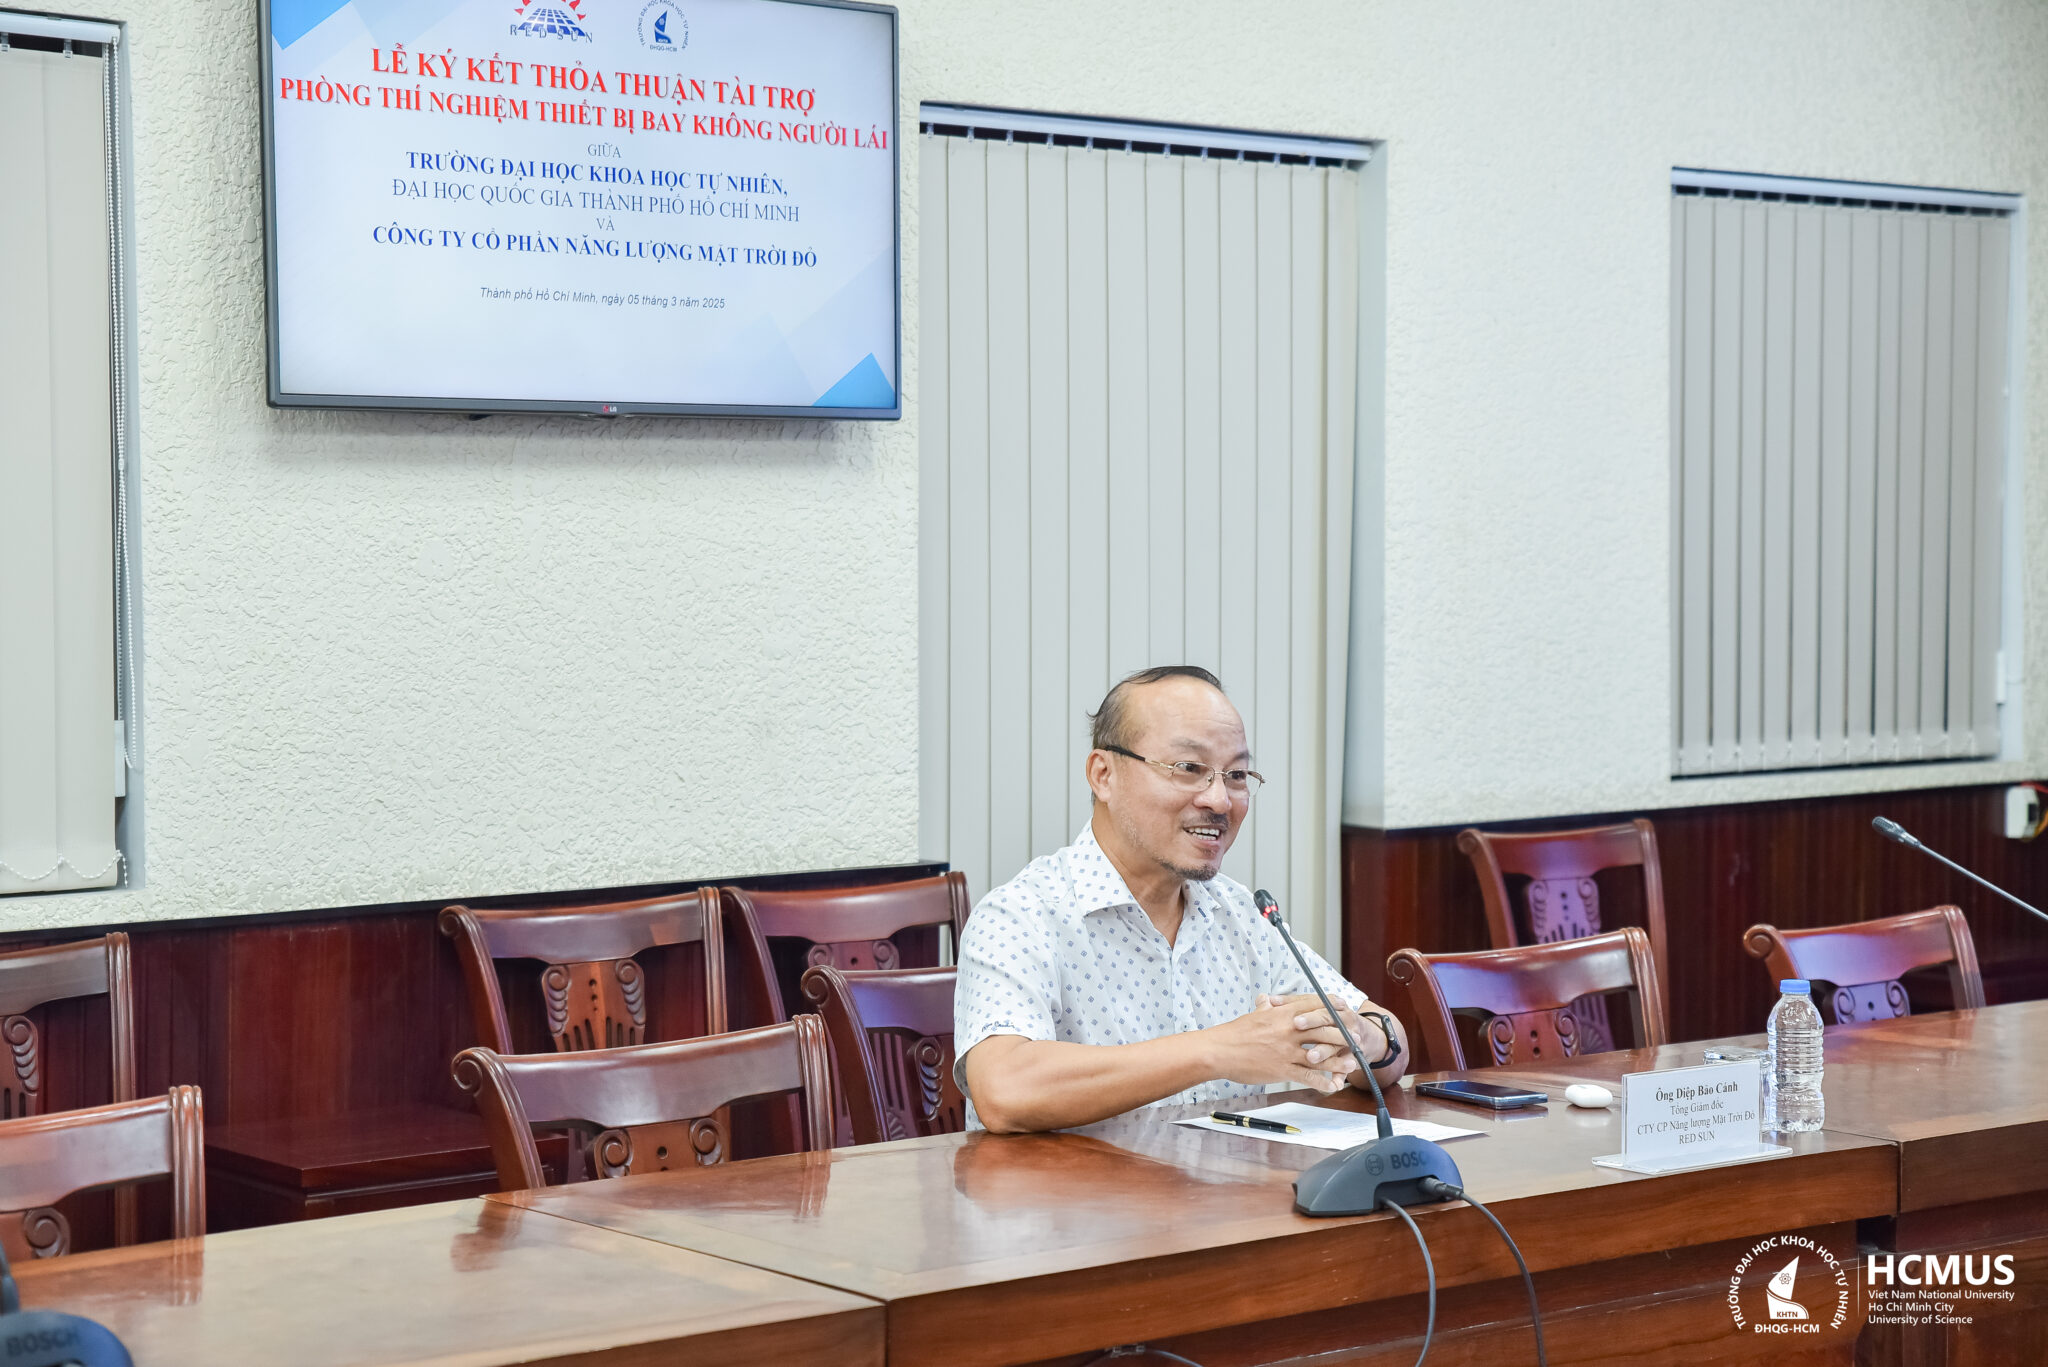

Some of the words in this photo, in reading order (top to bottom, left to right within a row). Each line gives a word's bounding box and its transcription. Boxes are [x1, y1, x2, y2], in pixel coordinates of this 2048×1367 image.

[371, 42, 410, 74] LỄ
[417, 48, 457, 79] KÝ
[466, 52, 523, 85] KẾT
[530, 59, 607, 94] THỎA
[615, 71, 706, 106] THUẬN
[713, 76, 757, 106] TÀI
[763, 86, 817, 117] TRỢ
[279, 75, 371, 106] PHÒNG
[378, 84, 422, 111] THÍ
[429, 91, 529, 124] NGHIỆM
[535, 98, 607, 126] THIẾT
[613, 107, 635, 135] BỊ
[641, 109, 688, 134] BAY
[693, 112, 773, 141] KHÔNG
[778, 121, 848, 147] NGƯỜI
[853, 124, 889, 150] LÁI
[587, 143, 622, 159] GIỮA
[406, 150, 495, 175] TRƯỜNG
[500, 158, 537, 181] ĐẠI
[541, 161, 584, 184] HỌC
[589, 166, 645, 185] KHOA
[650, 170, 693, 192] HỌC
[696, 172, 723, 195] TỰ
[727, 173, 788, 197] NHIÊN,
[392, 178, 427, 200] ĐẠI
[434, 181, 475, 203] HỌC
[480, 182, 536, 206] QUỐC
[540, 189, 574, 208] GIA
[579, 189, 643, 212] THÀNH
[719, 198, 750, 219] CHÍ
[754, 203, 800, 222] MINH
[596, 215, 615, 232] VÀ
[373, 221, 433, 247] CÔNG
[438, 230, 467, 248] TY
[565, 233, 620, 256] NĂNG
[625, 240, 692, 264] LƯỢNG
[743, 245, 787, 266] TRỜI
[792, 247, 818, 268] ĐỎ
[480, 287, 511, 299] Thành
[552, 290, 570, 302] Chí
[572, 292, 598, 305] Minh,
[601, 295, 625, 307] ngày
[627, 295, 640, 305] 05
[642, 295, 668, 309] tháng
[671, 297, 677, 307] 3
[680, 297, 700, 308] năm
[702, 297, 725, 309] 2025
[1655, 1087, 1674, 1102] Ông
[1676, 1086, 1696, 1102] Diệp
[1690, 1102, 1709, 1113] Giám
[1637, 1123, 1654, 1135] CTY
[1656, 1122, 1668, 1132] CP
[1669, 1120, 1689, 1131] Năng
[1690, 1117, 1711, 1129] lượng
[1728, 1112, 1743, 1123] Trời
[1679, 1133, 1696, 1144] RED
[1698, 1130, 1715, 1142] SUN
[1390, 1150, 1427, 1170] BOSC
